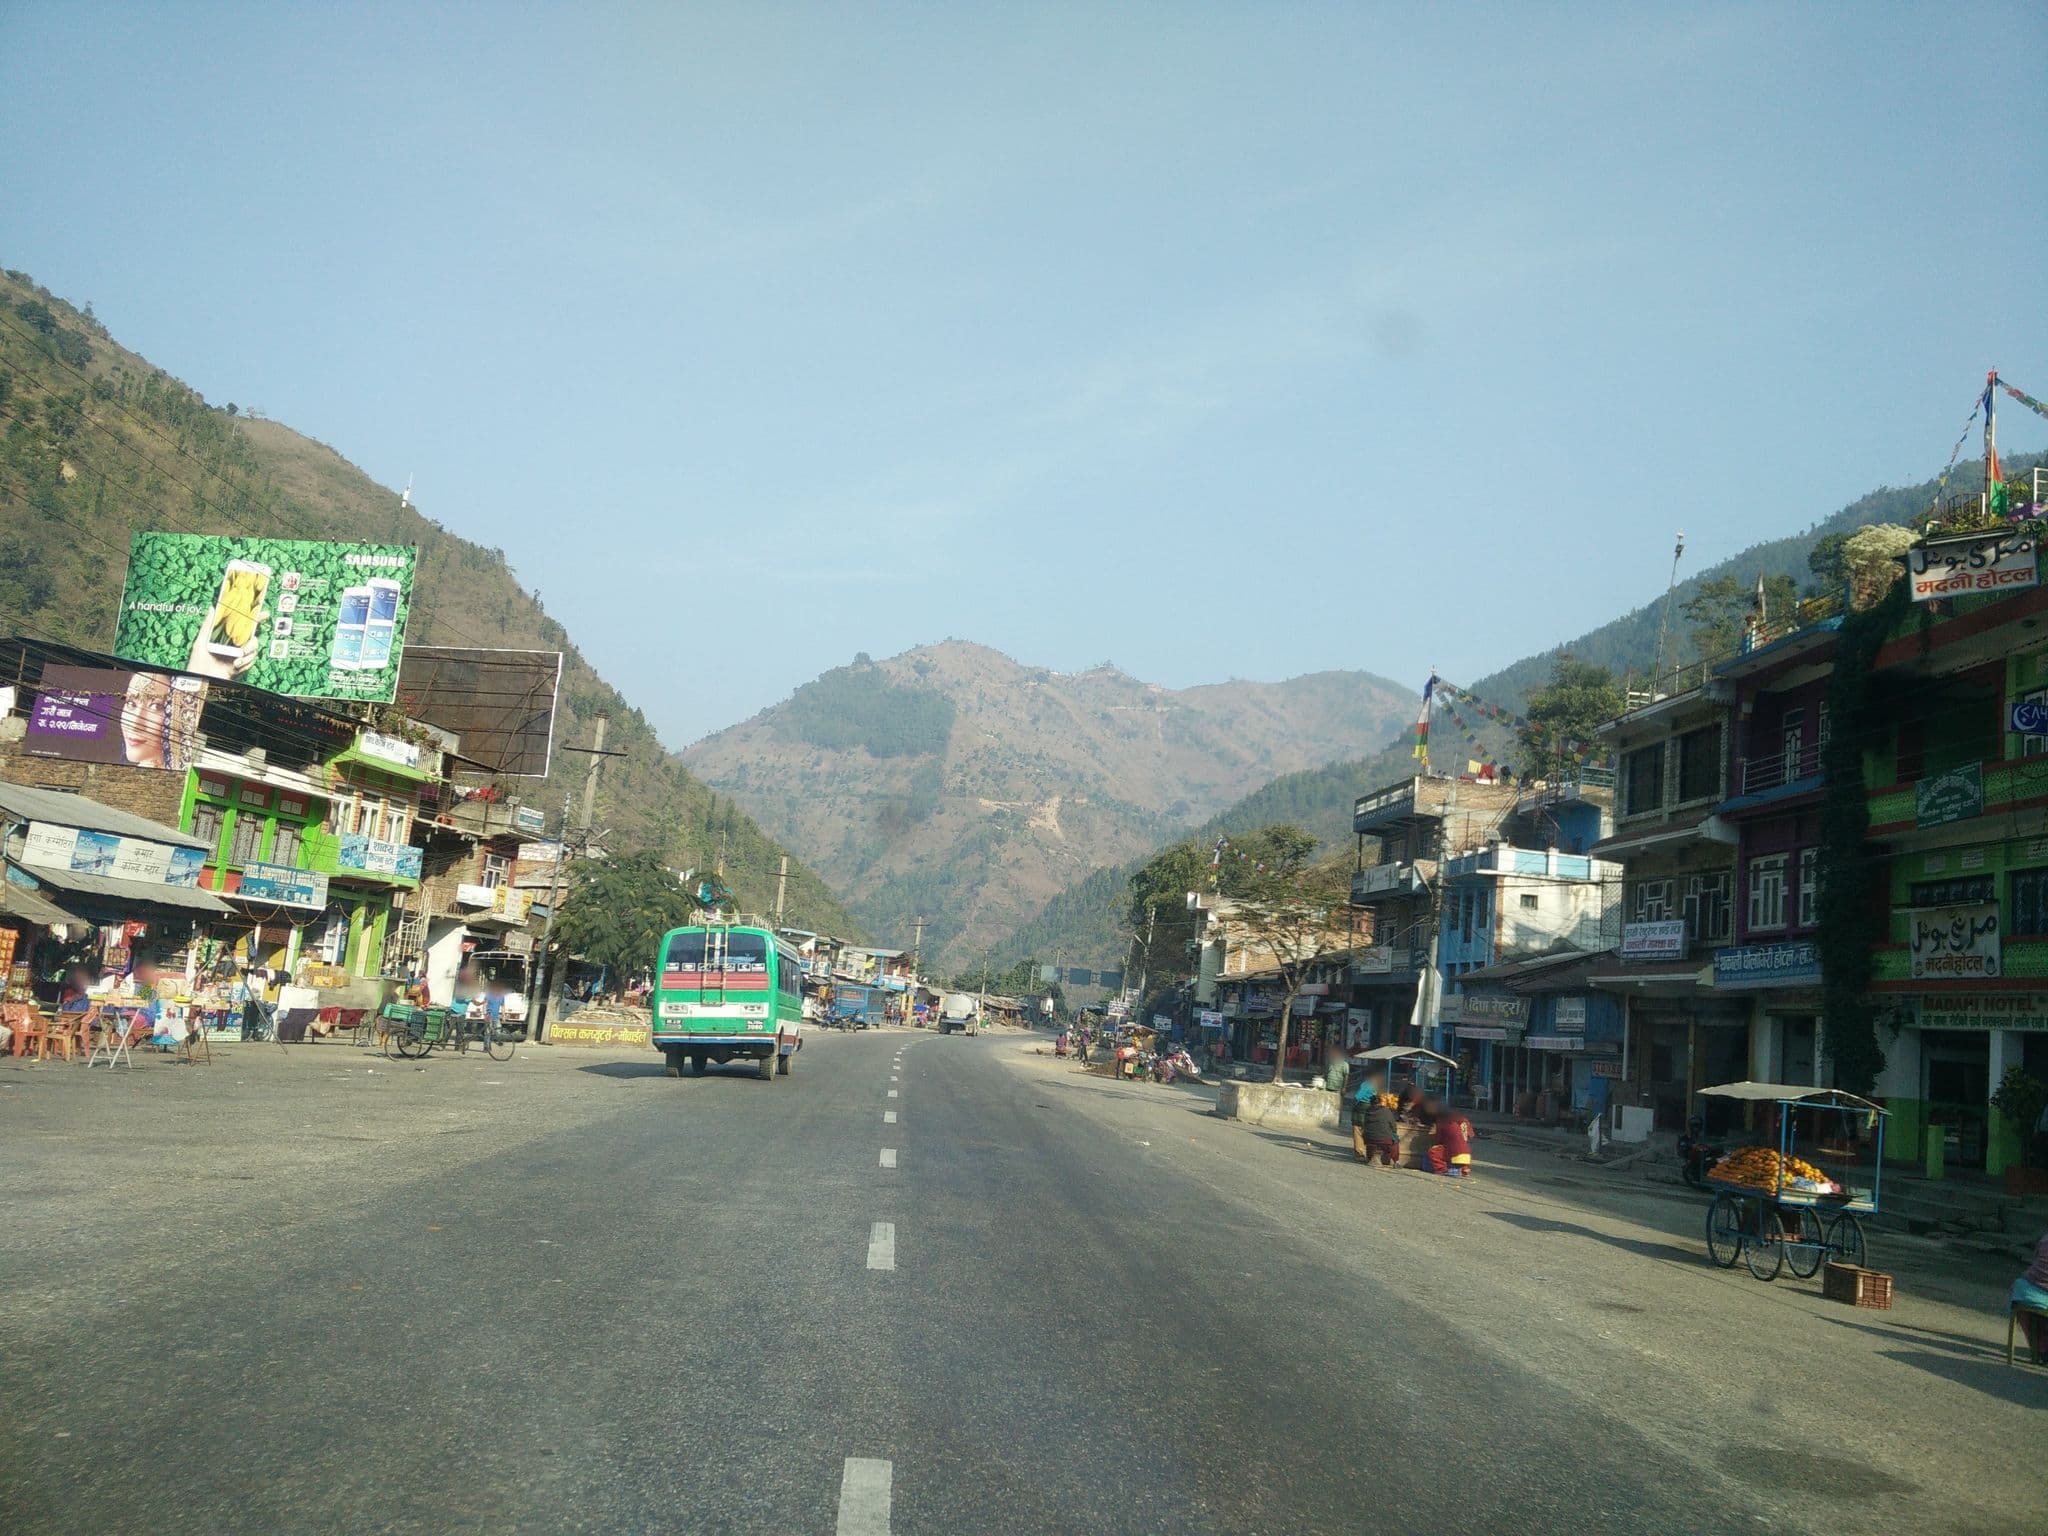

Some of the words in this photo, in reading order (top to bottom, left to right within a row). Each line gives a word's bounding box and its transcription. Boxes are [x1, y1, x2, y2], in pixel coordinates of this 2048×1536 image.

[345, 553, 405, 567] SAMSUNG
[1916, 572, 1975, 593] मदनी
[1976, 567, 2034, 589] होटल
[128, 601, 136, 610] A
[137, 602, 174, 612] handful
[175, 604, 185, 613] of
[1773, 946, 1795, 968] होटल
[1984, 994, 2033, 1011] HOTEL
[550, 1024, 577, 1040] पिक्सल
